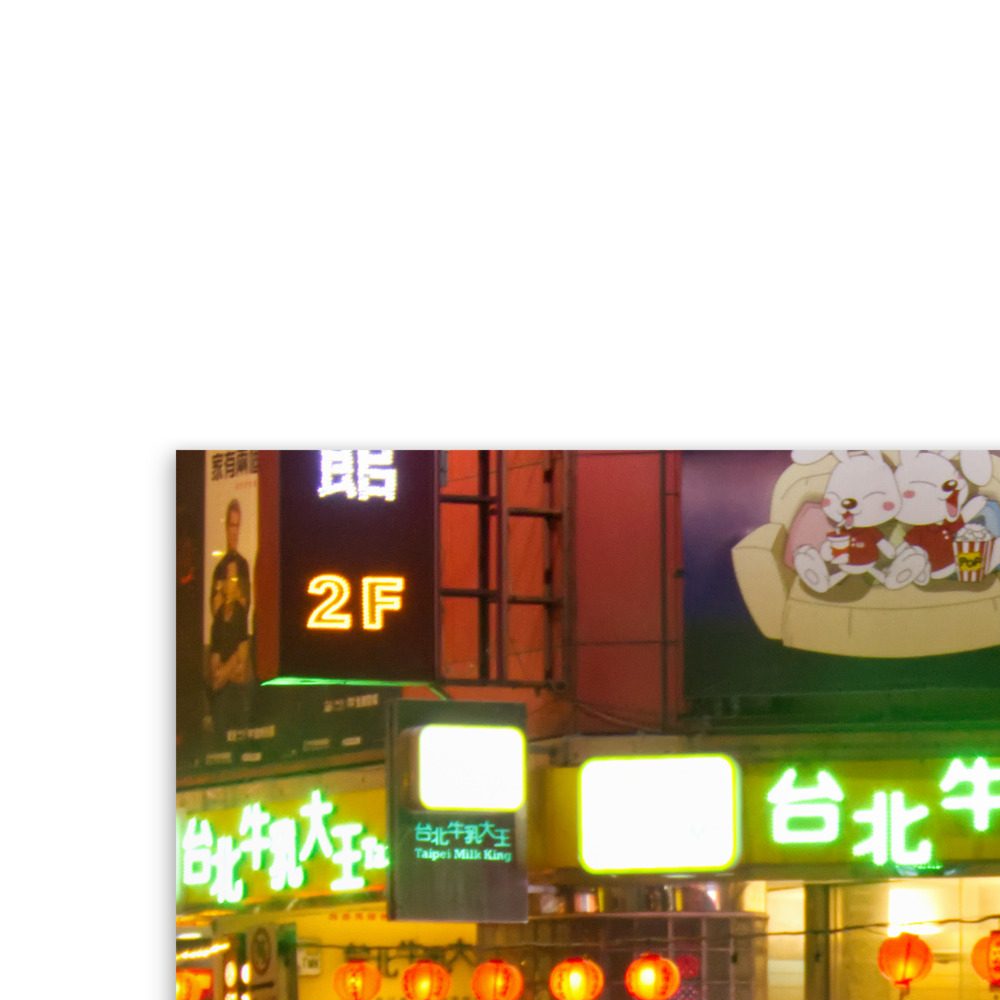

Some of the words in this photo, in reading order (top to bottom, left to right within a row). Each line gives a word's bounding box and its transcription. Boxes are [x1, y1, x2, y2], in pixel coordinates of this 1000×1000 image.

[306, 573, 406, 631] 2F
[182, 788, 366, 904] 台北牛乳大王
[414, 820, 512, 847] 台北牛乳大王
[414, 847, 451, 861] Taipei
[453, 847, 481, 860] Milk
[483, 848, 513, 863] King
